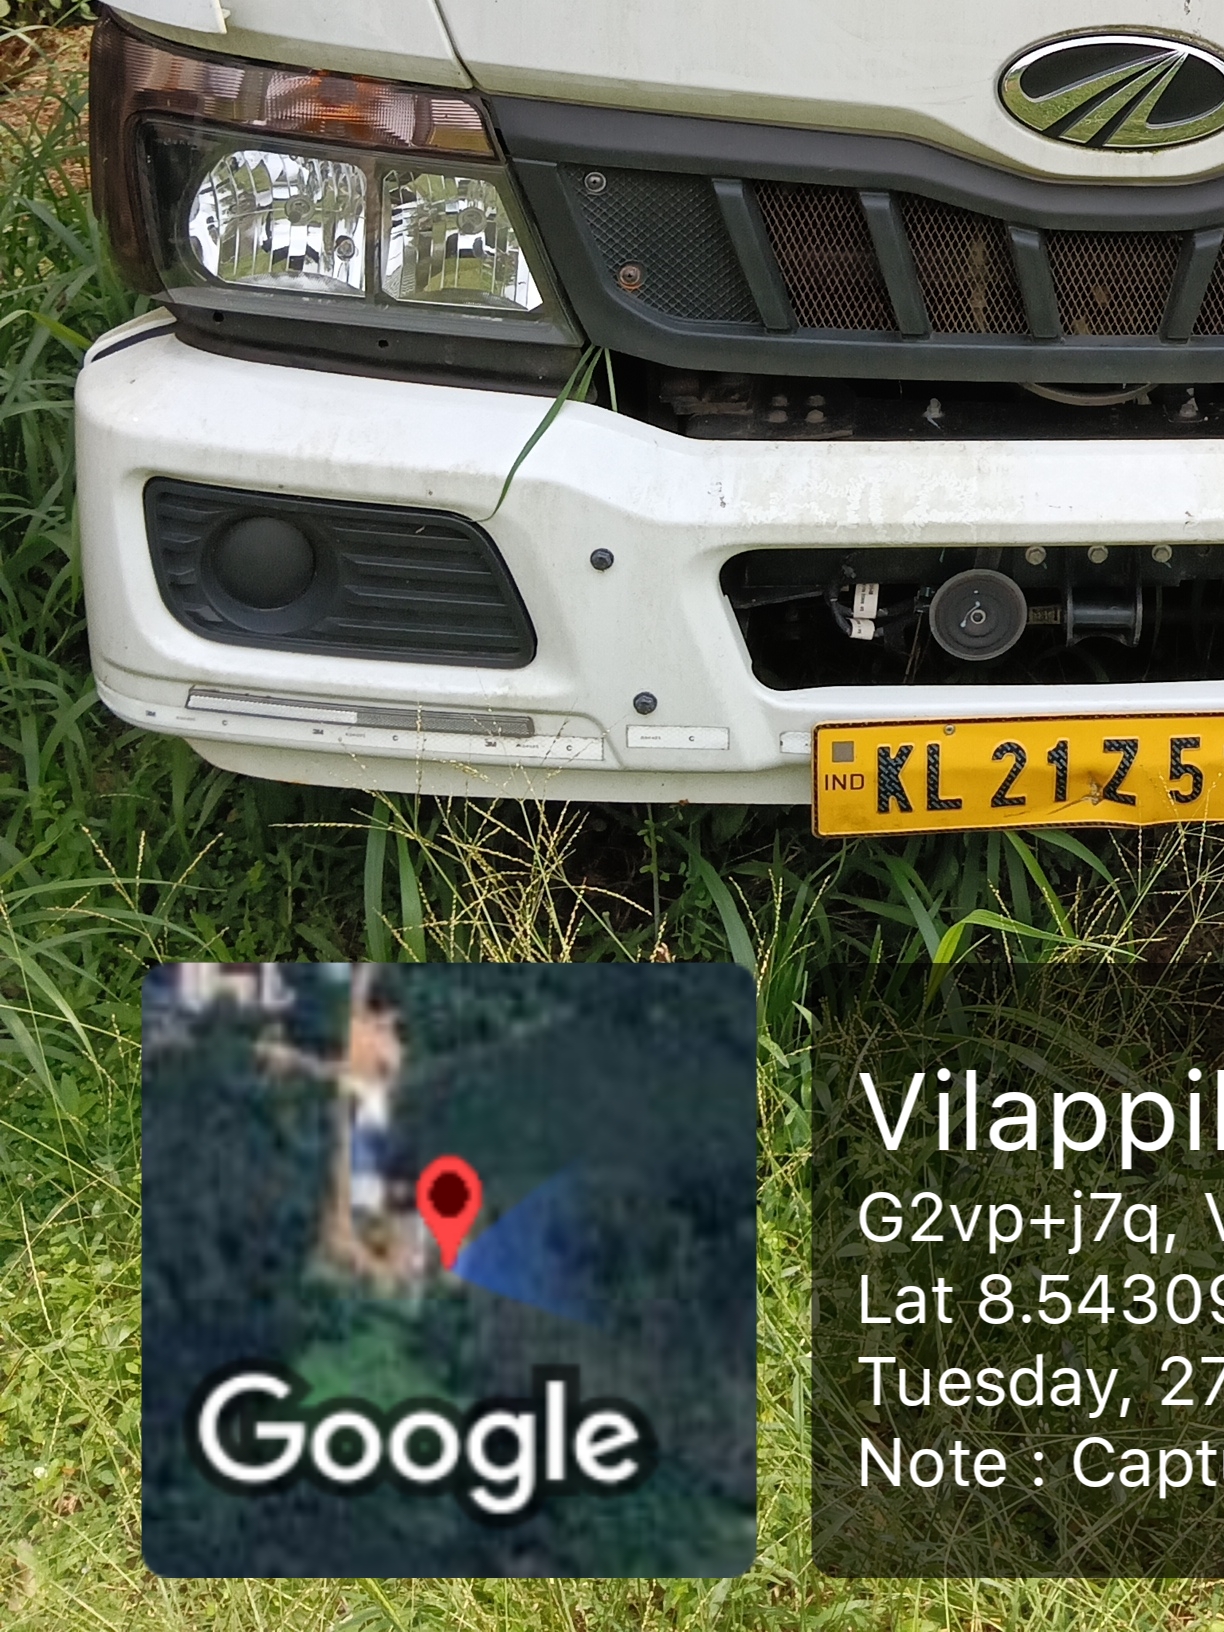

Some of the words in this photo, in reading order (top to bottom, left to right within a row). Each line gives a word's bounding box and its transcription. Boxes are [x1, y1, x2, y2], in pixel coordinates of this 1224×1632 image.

[824, 772, 866, 792] IND
[876, 743, 963, 814] KL
[990, 739, 1069, 808] 21
[1101, 737, 1140, 806] Z
